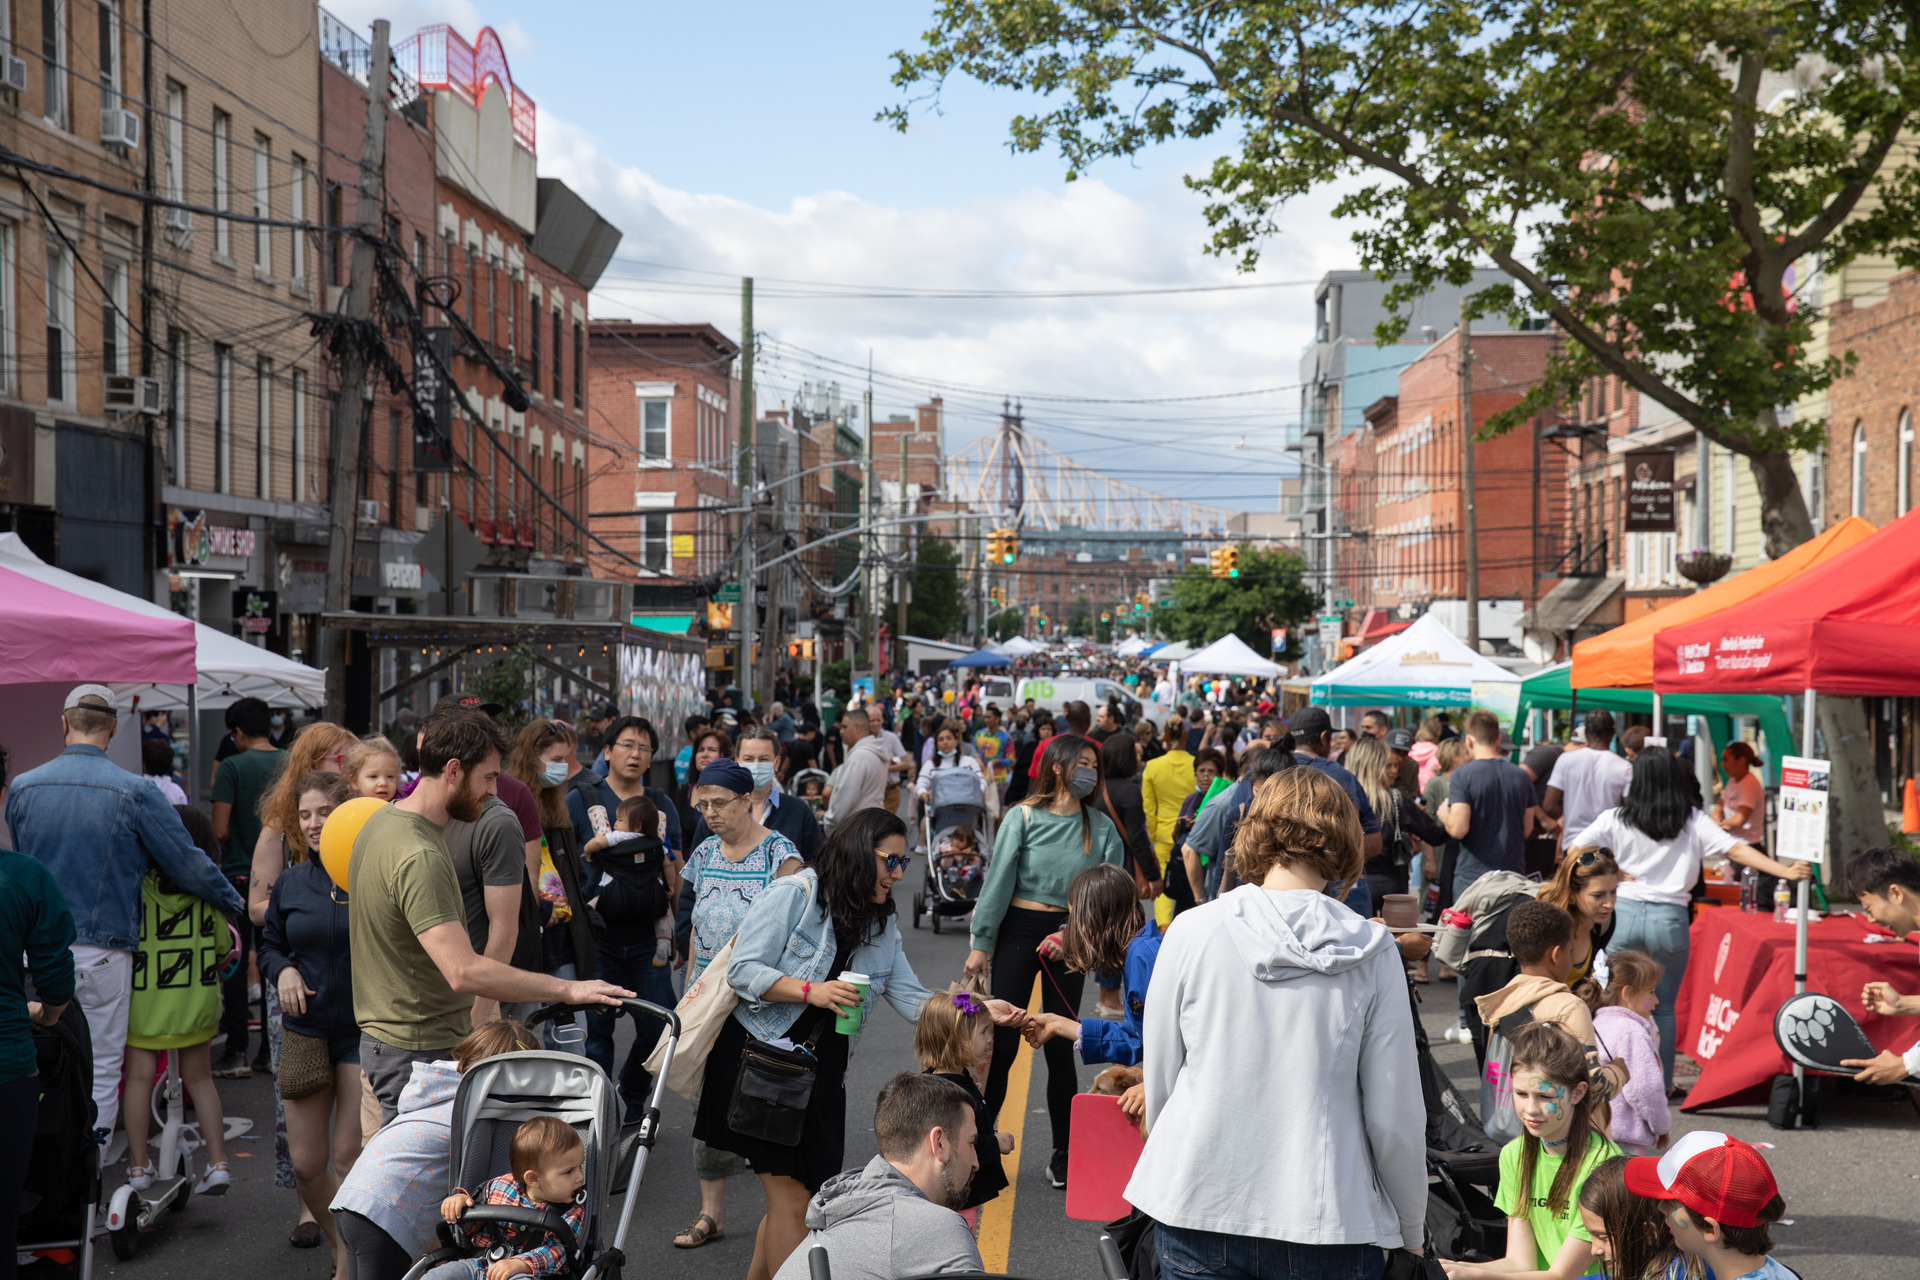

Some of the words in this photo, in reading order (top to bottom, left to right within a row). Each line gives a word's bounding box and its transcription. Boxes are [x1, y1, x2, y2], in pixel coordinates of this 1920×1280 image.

[209, 525, 235, 555] SMOKE
[236, 529, 255, 557] SHOP
[383, 556, 422, 589] verizon
